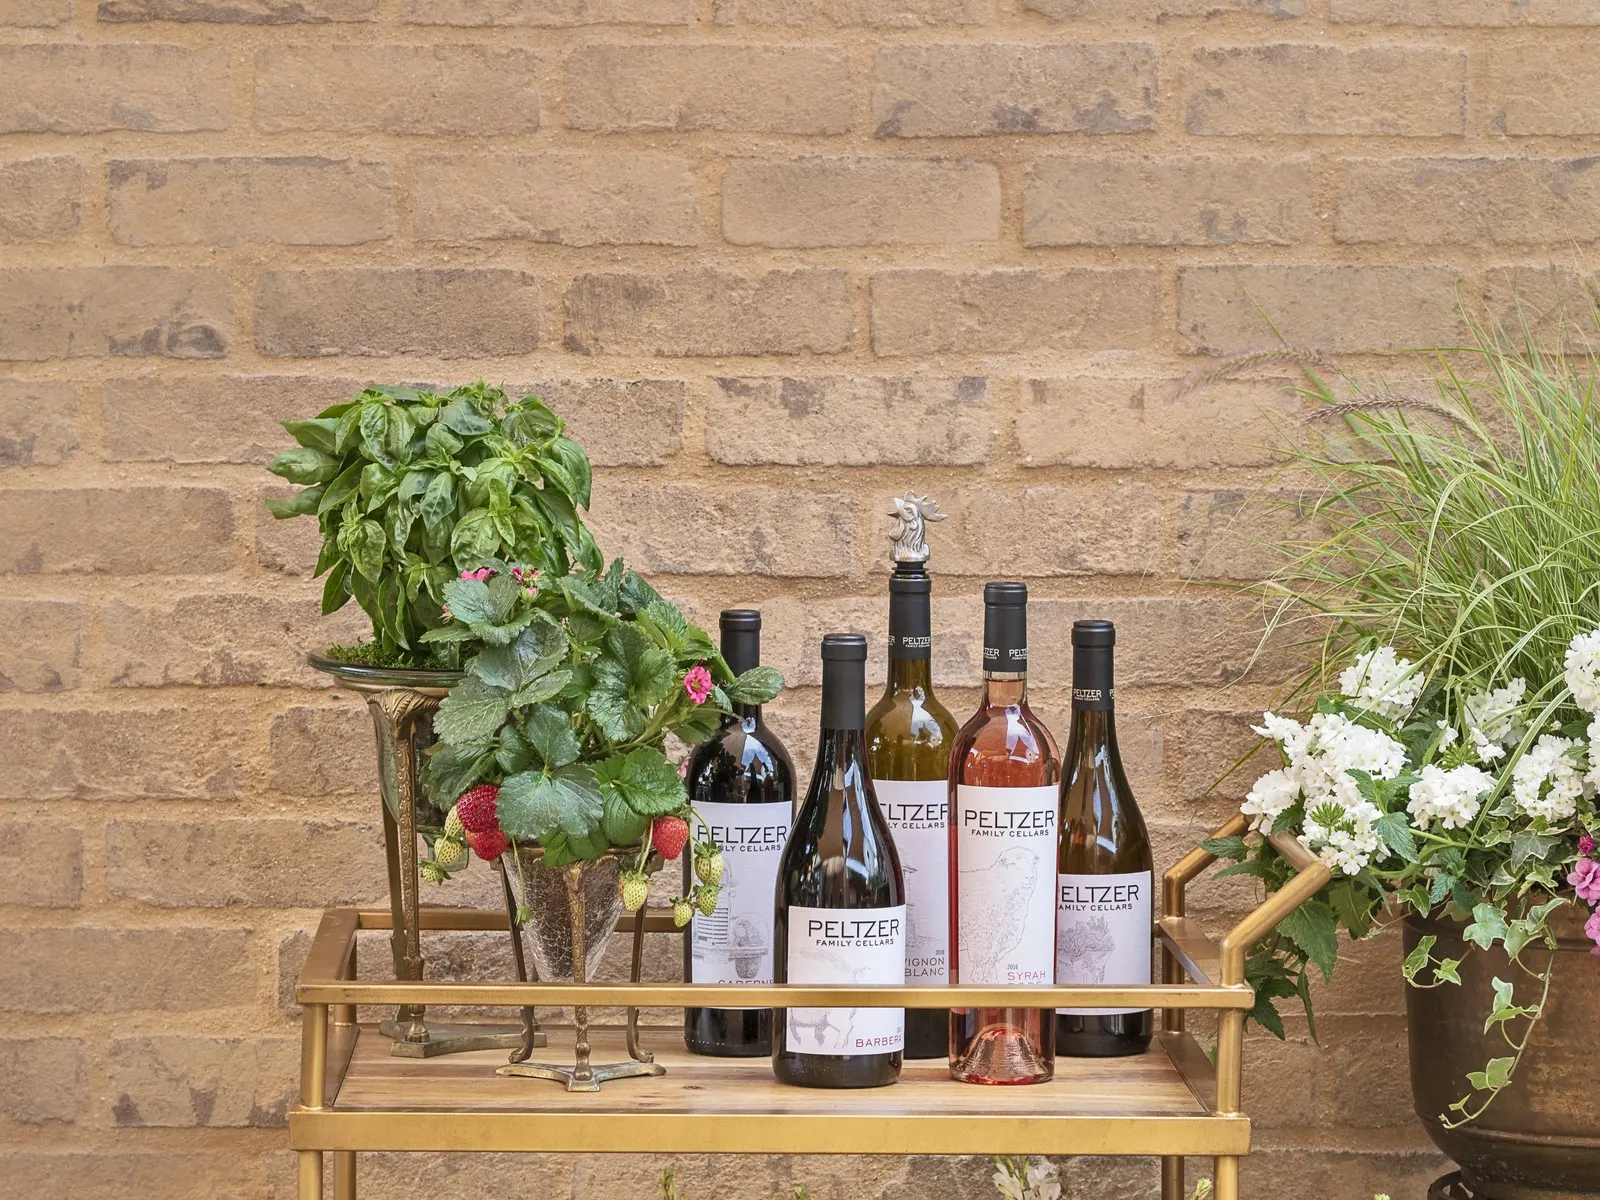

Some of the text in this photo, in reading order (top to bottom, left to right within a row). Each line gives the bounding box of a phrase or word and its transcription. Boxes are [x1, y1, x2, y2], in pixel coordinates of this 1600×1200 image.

[984, 647, 1000, 657] TZER
[880, 803, 948, 821] LTZER
[964, 809, 1055, 829] PELTZER
[902, 821, 945, 829] CELLARS
[697, 824, 788, 844] PELTZER
[971, 828, 1049, 838] FAMILY CELLARS
[739, 843, 781, 852] CELLARS
[1061, 884, 1140, 903] ELTZER
[1090, 903, 1133, 912] CELLARS
[808, 918, 900, 939] PELTZER
[816, 938, 894, 947] FAMILY CELLARS
[905, 957, 945, 967] IGNON
[905, 967, 945, 977] BLANC
[1007, 970, 1046, 981] SYRAH
